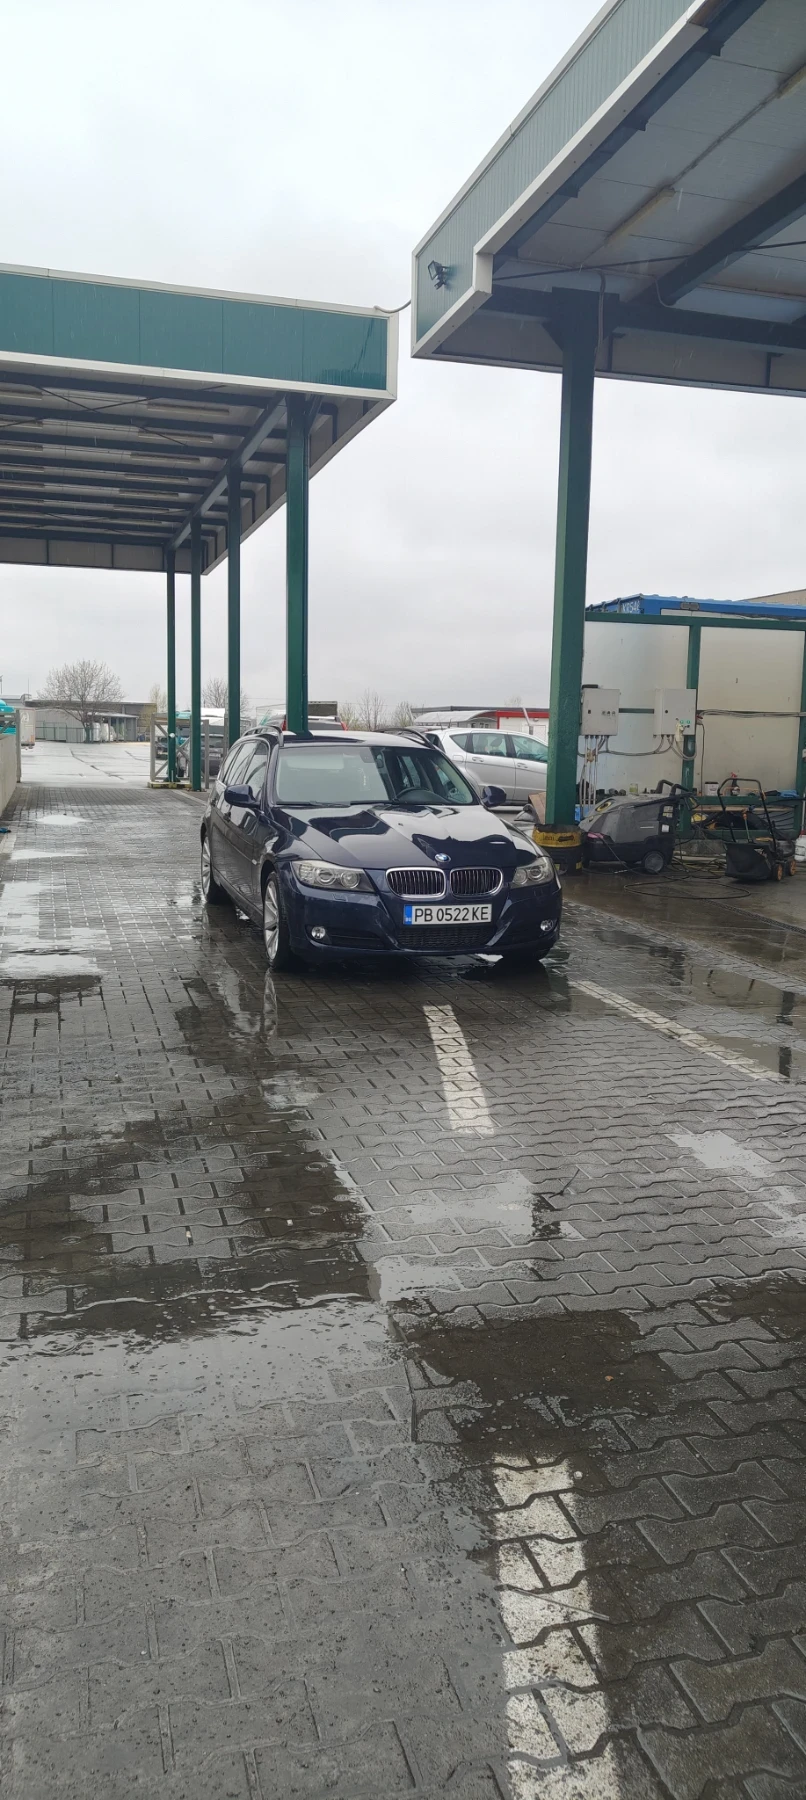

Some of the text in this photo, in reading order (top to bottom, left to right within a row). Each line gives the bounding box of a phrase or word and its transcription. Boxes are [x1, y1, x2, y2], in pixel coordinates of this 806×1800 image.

[414, 906, 489, 922] PB 0522 KE
